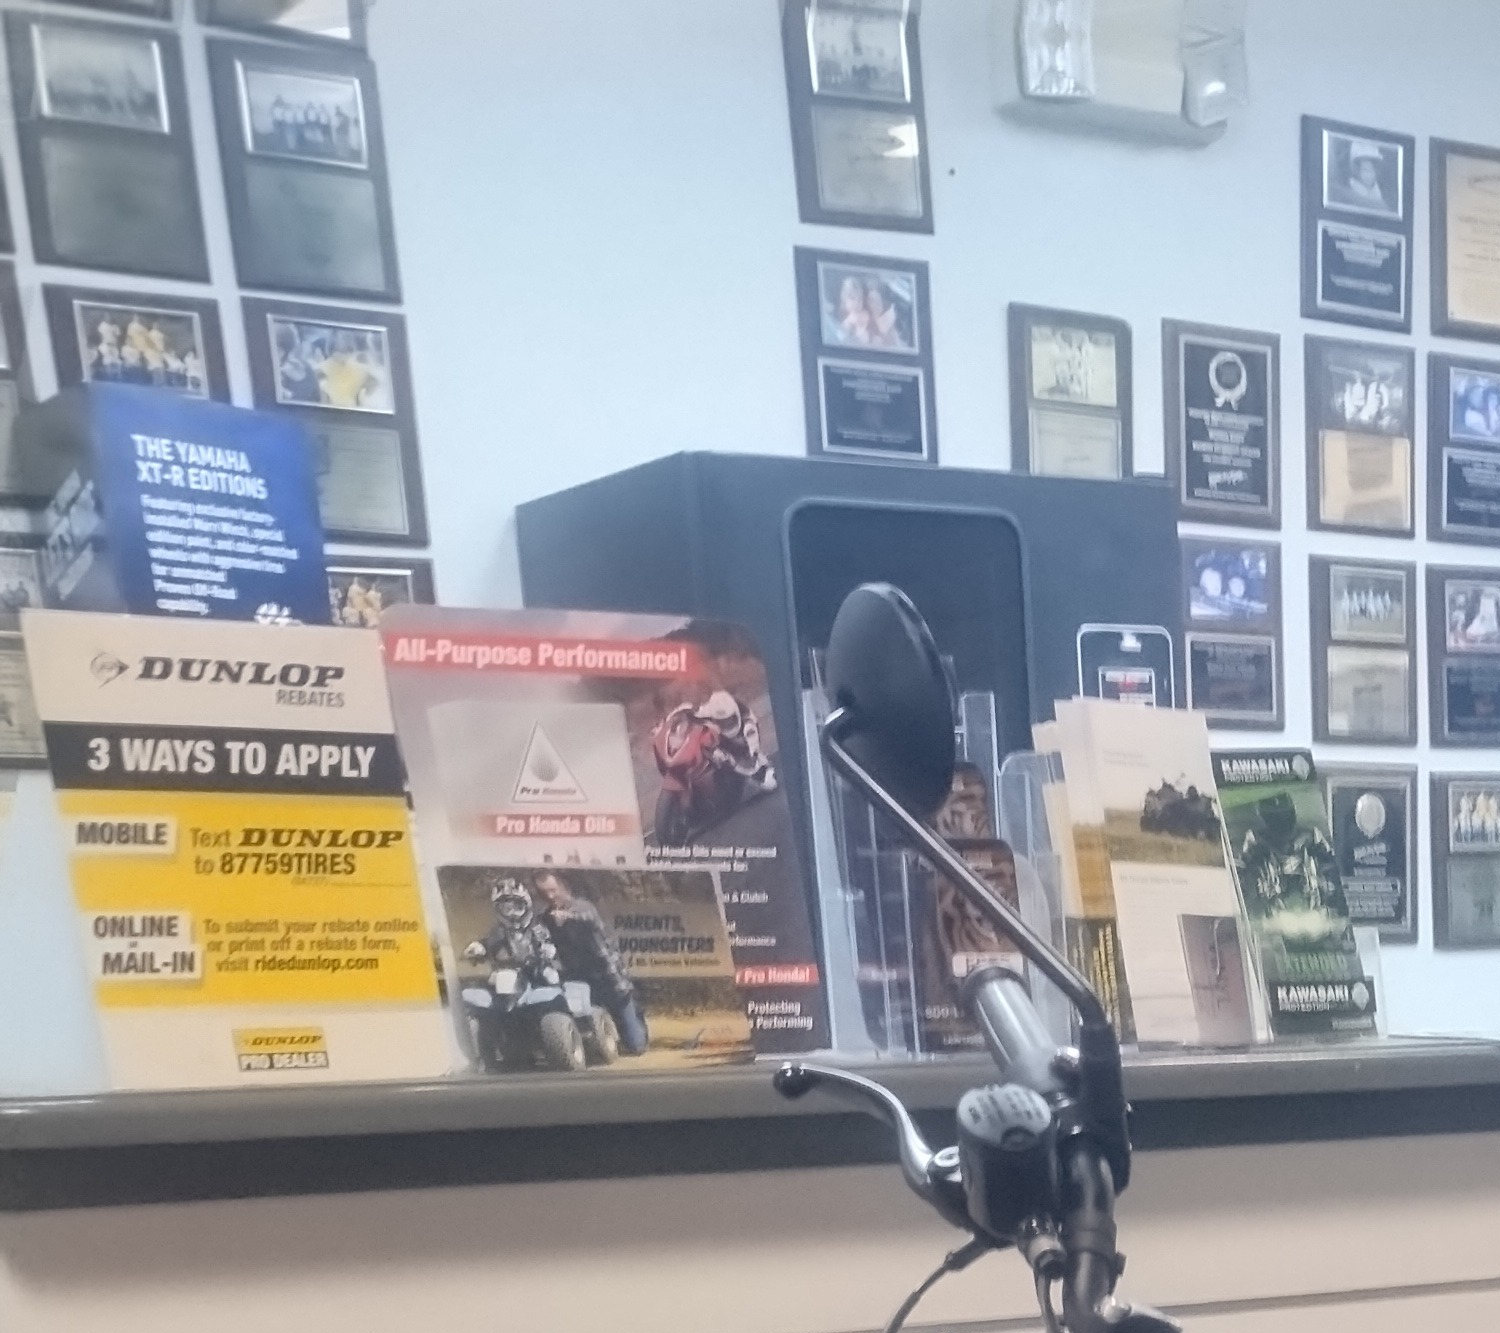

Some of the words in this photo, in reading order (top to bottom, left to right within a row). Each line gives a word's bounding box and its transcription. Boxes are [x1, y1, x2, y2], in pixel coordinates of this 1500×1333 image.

[130, 434, 175, 461] THE
[175, 441, 251, 473] YAMAHA
[135, 460, 185, 487] XT-R
[188, 468, 268, 499] EDITIONS
[394, 638, 532, 669] All-Purpose
[538, 643, 688, 673] Performance!
[136, 656, 345, 688] DUNLOP
[276, 689, 345, 708] REBATES
[87, 737, 111, 771] 3
[120, 738, 215, 773] WAYS
[224, 741, 267, 776] TO
[275, 744, 375, 778] APPLY
[1221, 759, 1290, 774] KAWASAKI
[77, 822, 168, 846] MOBILE
[496, 817, 525, 833] Pro
[529, 817, 580, 833] Honda
[584, 816, 616, 833] Oils
[190, 827, 231, 848] Text
[238, 828, 404, 848] DUNLOP
[194, 856, 215, 874] to
[220, 853, 356, 875] 87759TIRES
[94, 915, 179, 939] ONLINE
[203, 918, 219, 934] To
[226, 918, 280, 934] submit
[284, 920, 316, 939] your
[321, 919, 370, 934] rebate
[374, 919, 418, 933] online
[207, 939, 223, 952] or
[228, 937, 266, 957] print
[270, 936, 292, 952] off
[296, 940, 305, 951] a
[310, 937, 357, 951] rebate
[362, 937, 400, 953] form,
[102, 951, 195, 976] MAIL-IN
[216, 958, 249, 973] visit
[254, 956, 379, 974] ridedunlop.com
[744, 967, 765, 984] Pro
[1278, 985, 1348, 1002] KAWASAKI
[747, 1000, 801, 1017] Protecting
[756, 1015, 813, 1031] Performing
[251, 1035, 323, 1047] DUNLOP
[241, 1054, 270, 1070] PRO
[275, 1052, 327, 1068] DEALER
